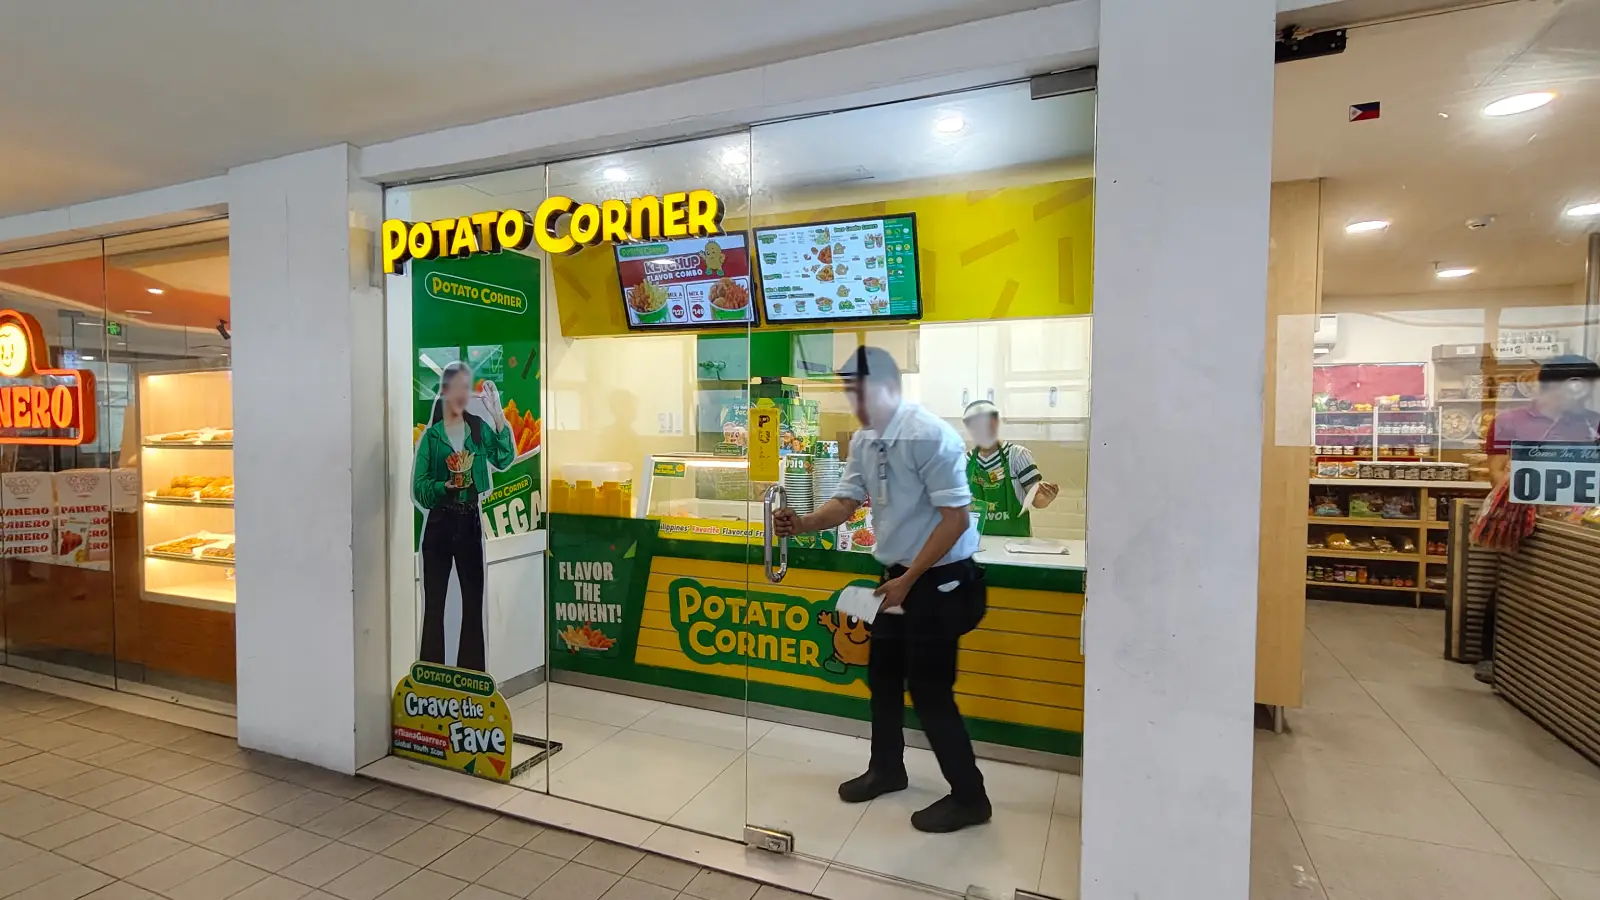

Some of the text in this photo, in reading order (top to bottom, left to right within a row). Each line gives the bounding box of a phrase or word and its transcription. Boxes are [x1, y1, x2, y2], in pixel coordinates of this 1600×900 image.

[382, 189, 722, 273] POTATO CORNER
[644, 255, 700, 274] KETCHUP
[647, 269, 702, 281] FLAVOR COMBO
[433, 277, 521, 308] POTATO CORNER
[0, 385, 72, 429] NERO
[1528, 447, 1557, 457] Come
[482, 480, 529, 504] OTATO CORNER
[1514, 468, 1600, 503] OPE
[660, 523, 690, 533] ilippines'
[693, 525, 720, 534] Favorite
[0, 545, 48, 555] ANERO
[559, 562, 613, 581] FLAVOR
[574, 582, 601, 602] THE
[556, 603, 622, 623] MOMENT!
[678, 587, 809, 631] POTATO
[688, 621, 820, 668] CORNER
[416, 667, 490, 691] POTATO CORNER
[405, 692, 484, 718] Crave the
[394, 740, 444, 757] Global Youth Icon
[450, 721, 506, 753] Fave
